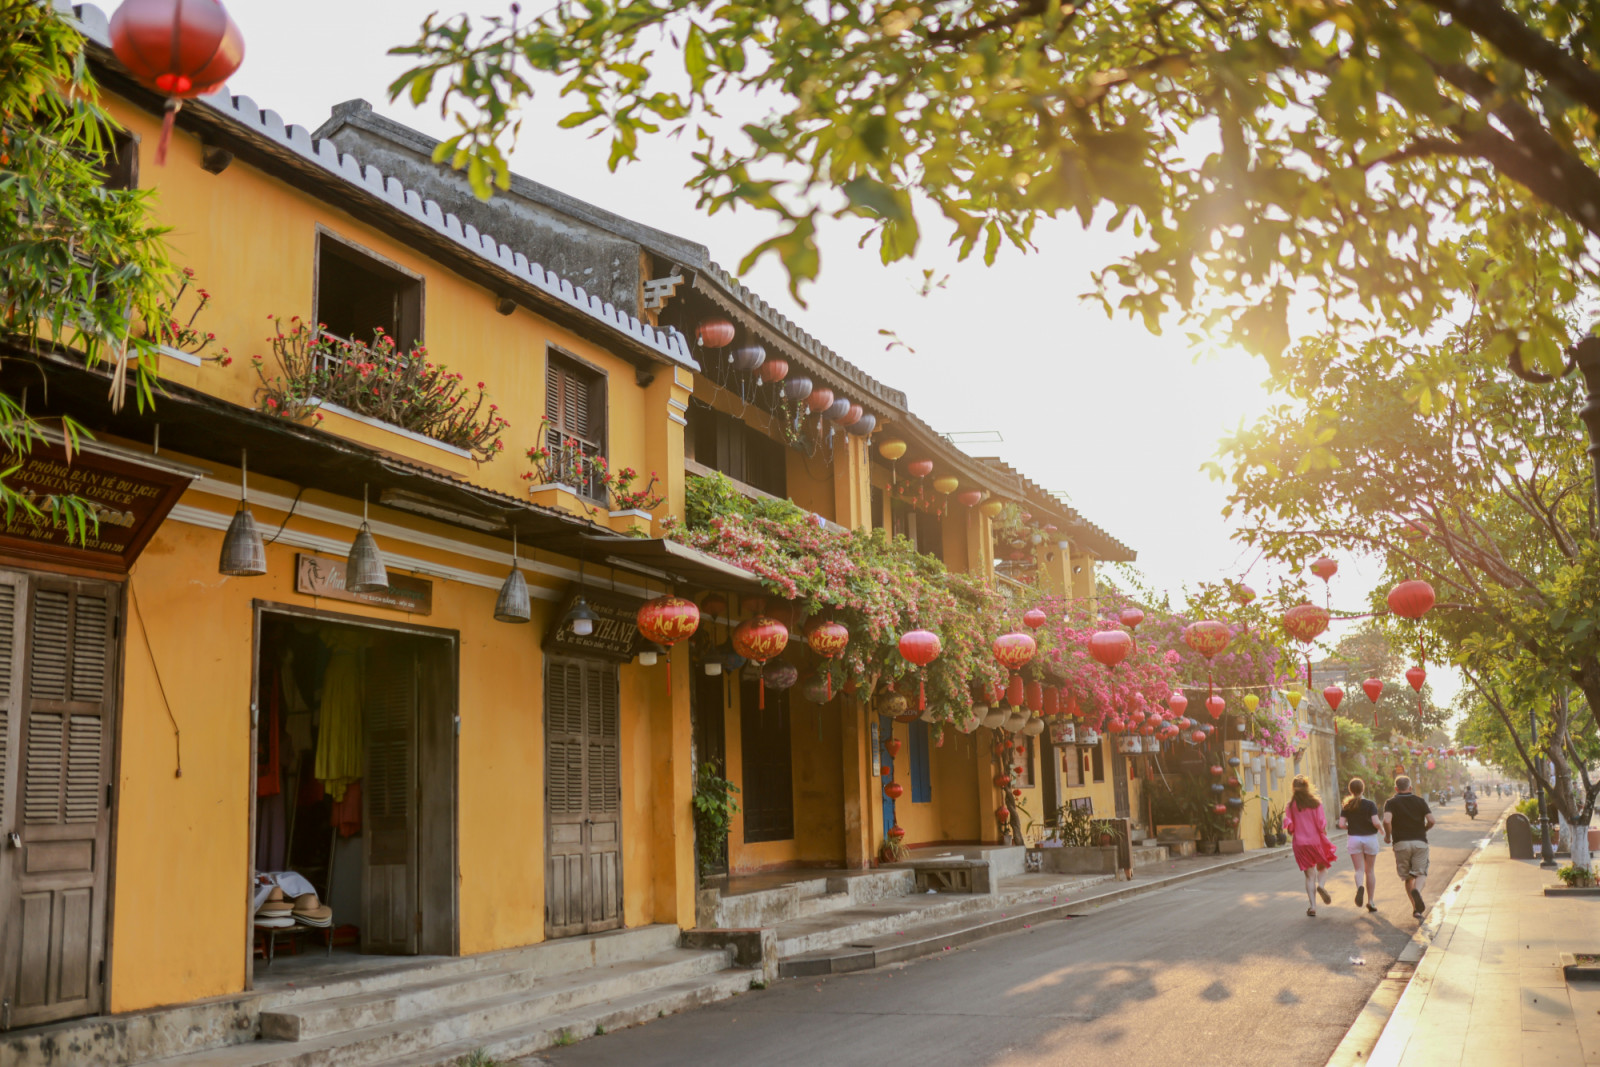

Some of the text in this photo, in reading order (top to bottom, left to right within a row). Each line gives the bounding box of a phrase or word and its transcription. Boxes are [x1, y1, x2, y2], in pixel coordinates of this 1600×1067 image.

[13, 469, 136, 505] BOOKING OFFICE
[117, 480, 134, 492] DU
[594, 617, 638, 643] THANH
[654, 613, 676, 635] Mai
[751, 634, 772, 653] Mai
